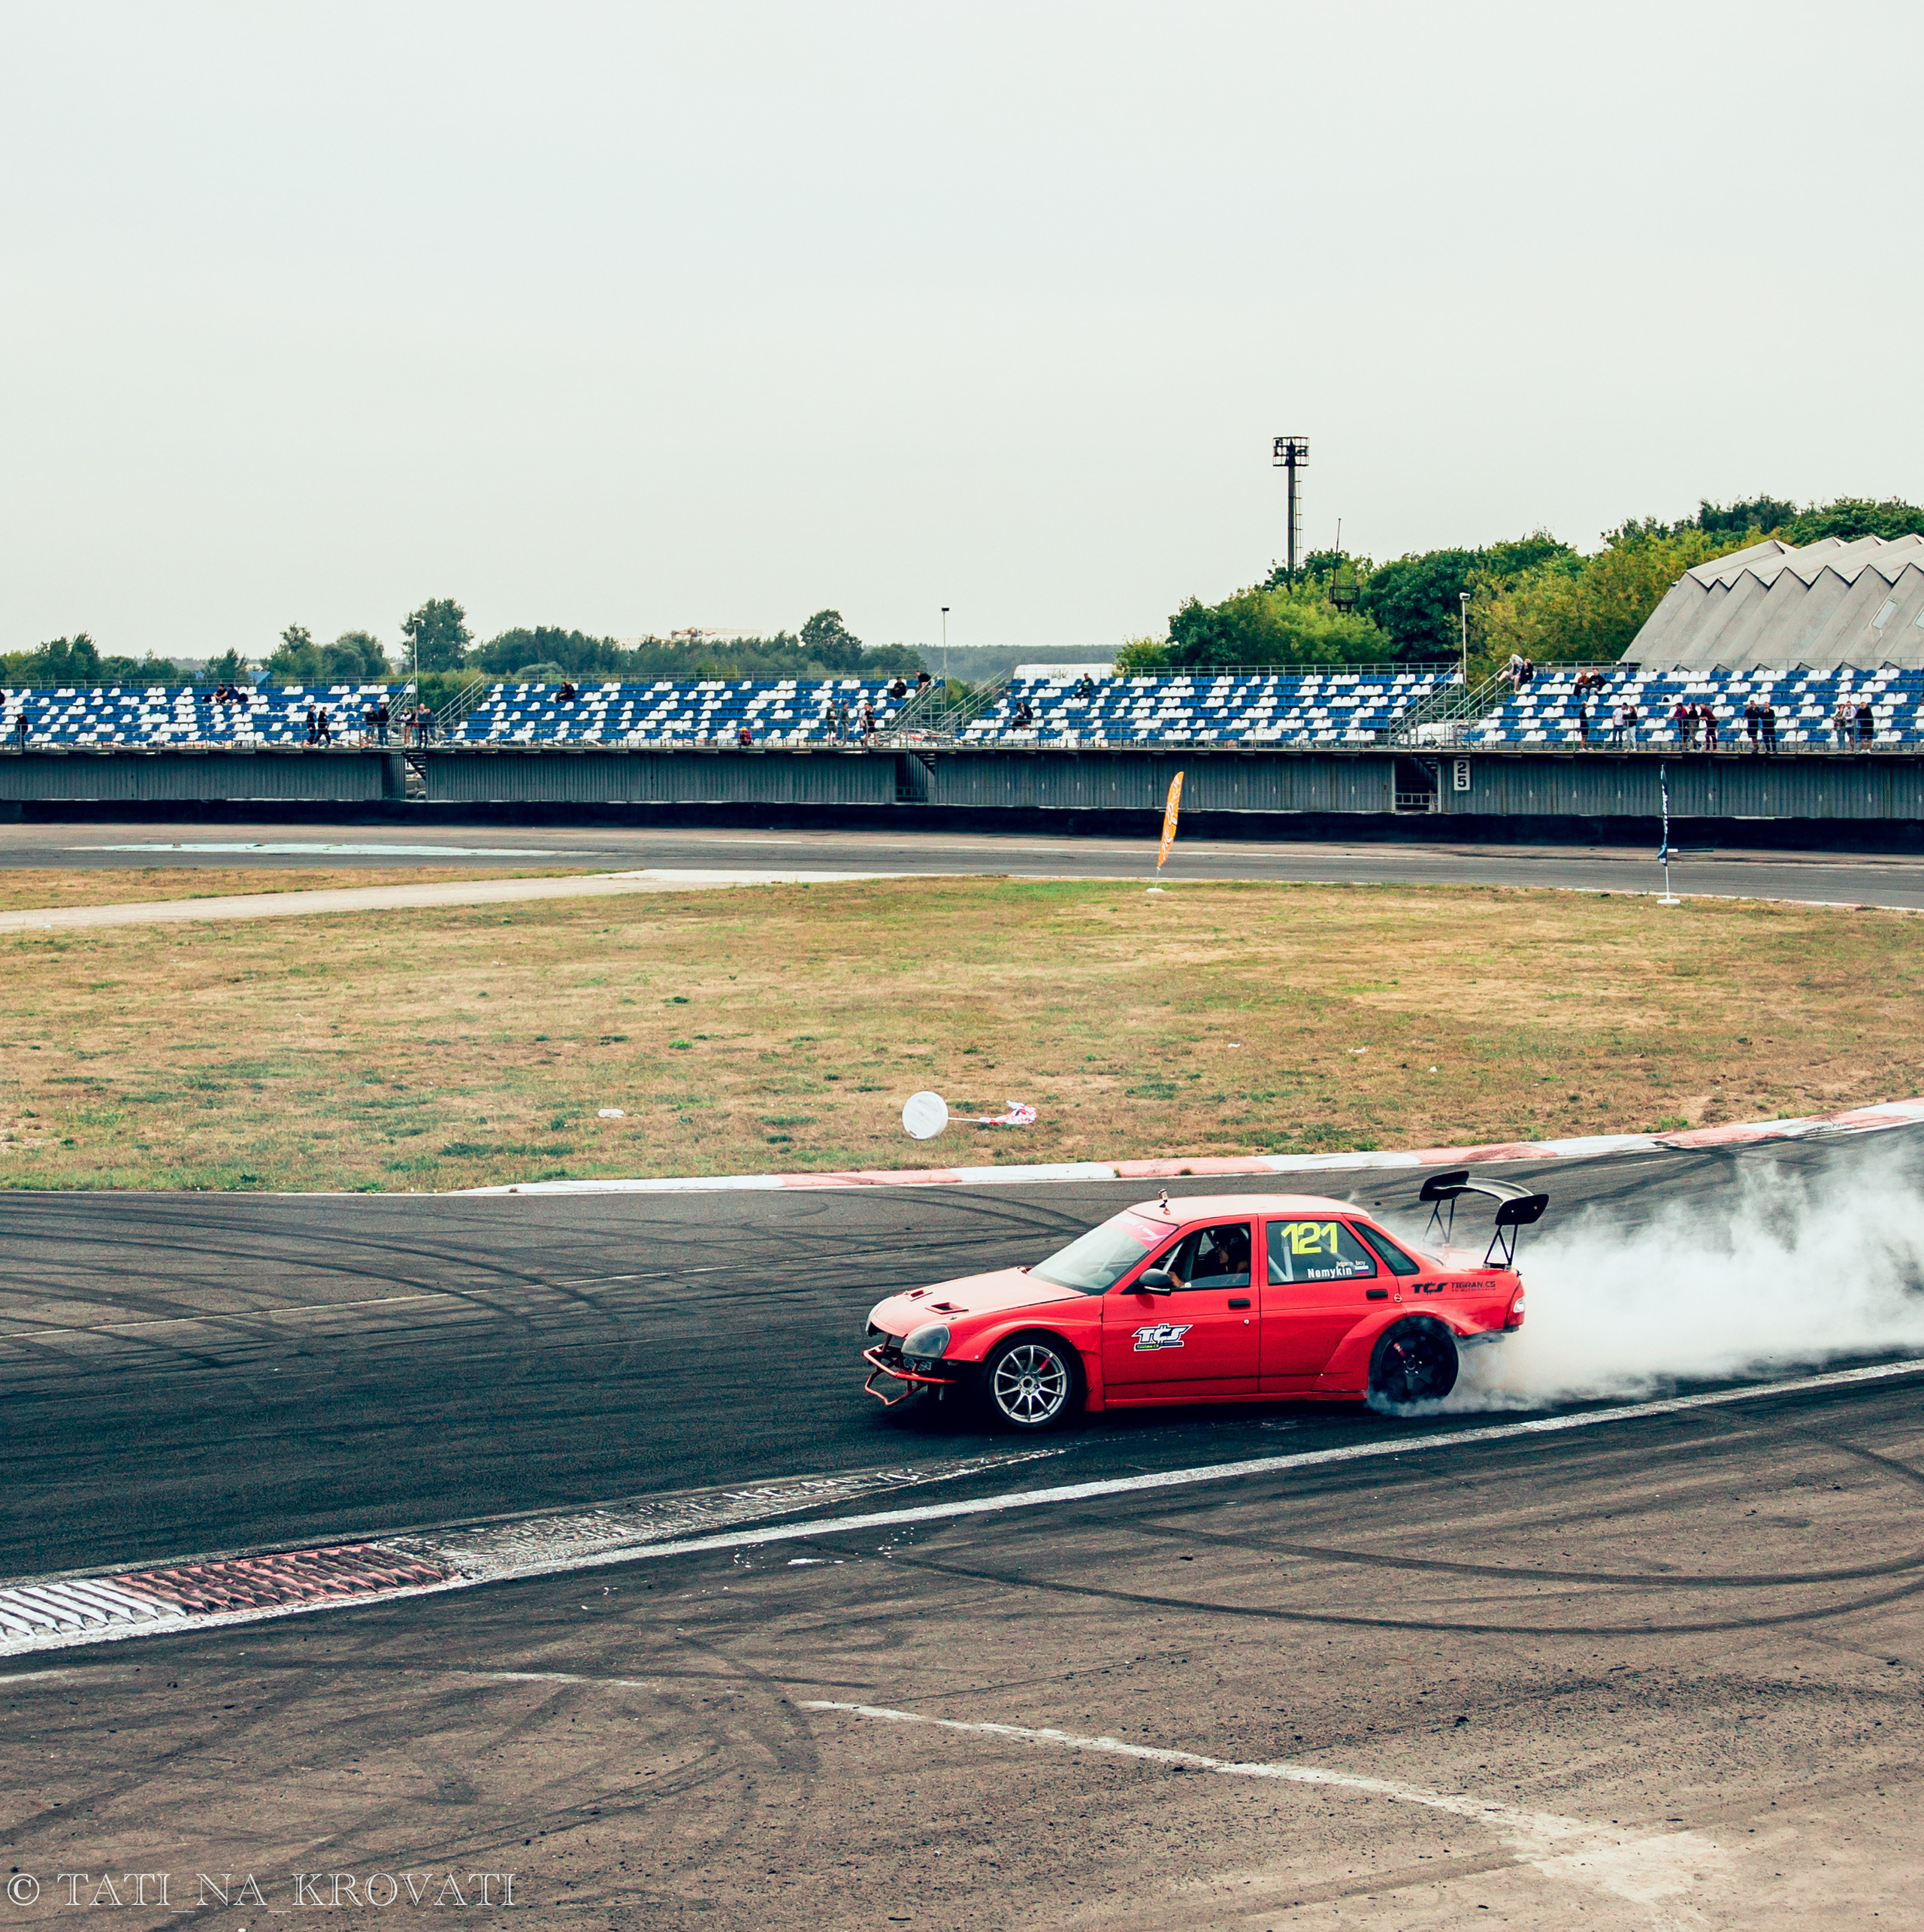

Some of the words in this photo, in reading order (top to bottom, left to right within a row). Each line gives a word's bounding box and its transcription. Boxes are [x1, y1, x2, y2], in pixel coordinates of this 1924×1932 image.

[1457, 762, 1467, 788] 25
[1281, 1222, 1338, 1255] 121
[1308, 1264, 1353, 1279] Nemykin
